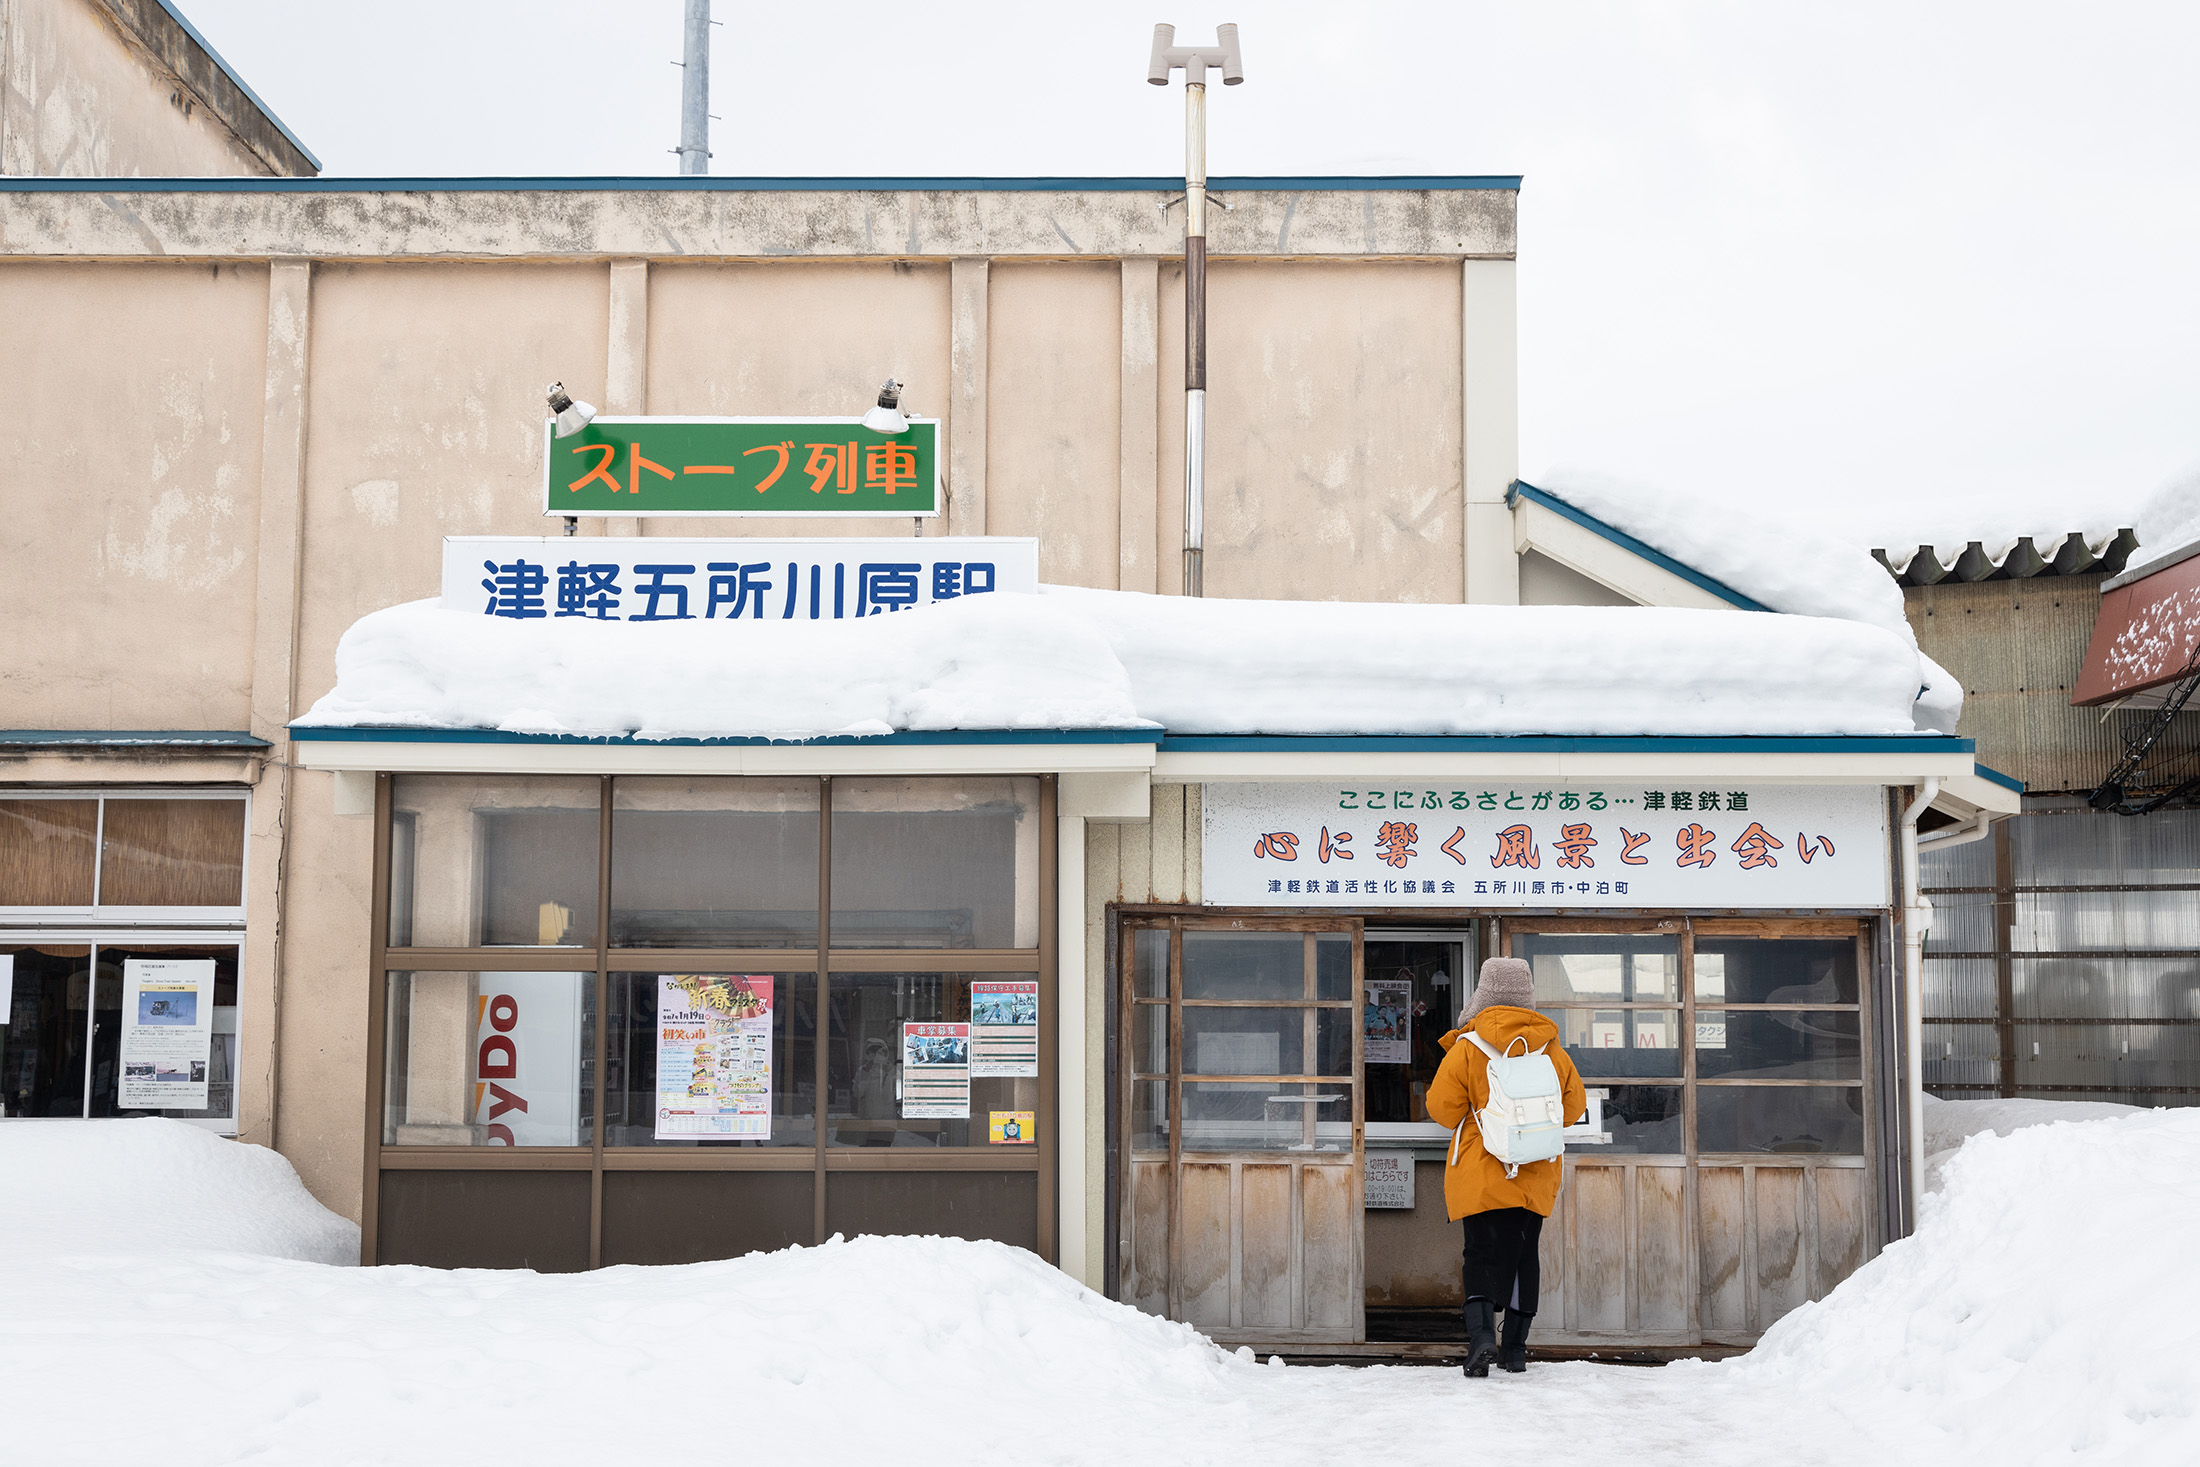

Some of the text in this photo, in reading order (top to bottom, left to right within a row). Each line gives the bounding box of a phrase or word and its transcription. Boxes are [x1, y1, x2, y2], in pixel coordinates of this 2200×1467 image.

[567, 440, 918, 495] ストーブ列車
[482, 558, 996, 622] 津軽五所川原駅
[1253, 820, 1837, 871] 心に響く風景と出会い
[1267, 879, 1629, 895] 津軽鉄道活性化協議会 五所川原市・中泊町
[916, 1025, 957, 1036] 車掌募集
